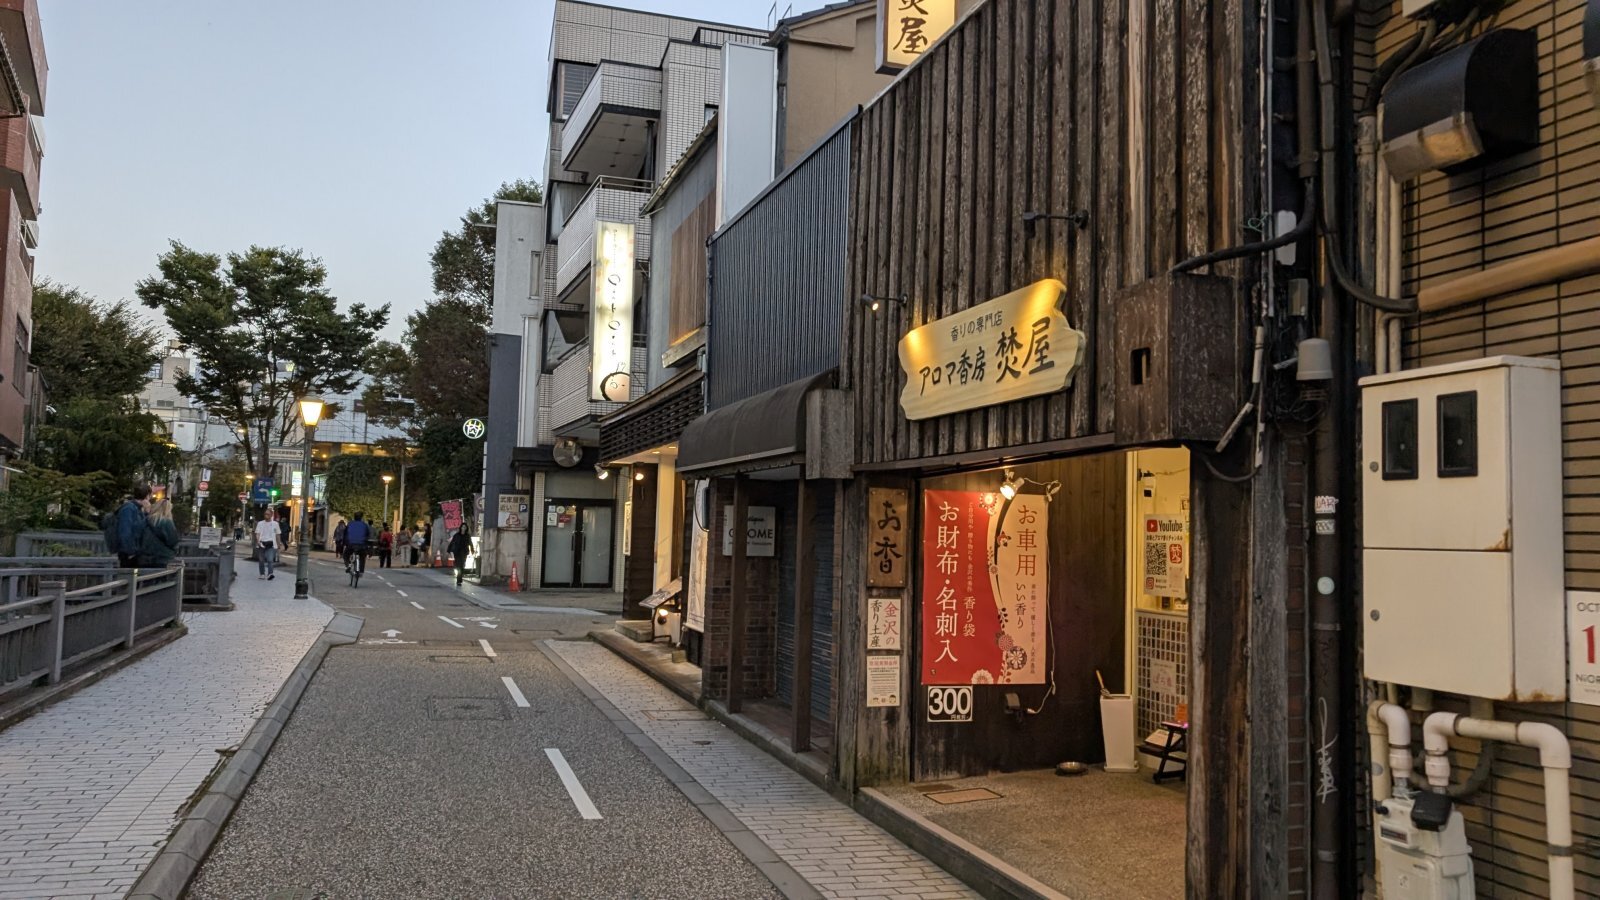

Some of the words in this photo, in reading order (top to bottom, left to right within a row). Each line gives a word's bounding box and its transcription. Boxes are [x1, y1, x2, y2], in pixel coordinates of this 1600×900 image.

[950, 310, 1004, 342] 香りの専門店
[919, 346, 986, 397] アロマ香房
[995, 316, 1055, 384] 焚屋
[728, 528, 773, 539] OME
[873, 500, 903, 574] お香
[1015, 504, 1038, 577] お車用
[1158, 519, 1183, 533] YouTube
[934, 501, 960, 663] お財布・名刺入
[869, 599, 882, 648] 香り土産
[883, 601, 900, 645] 金沢の
[963, 596, 976, 637] 香り袋
[1015, 582, 1027, 629] いい香り
[929, 688, 971, 715] 300
